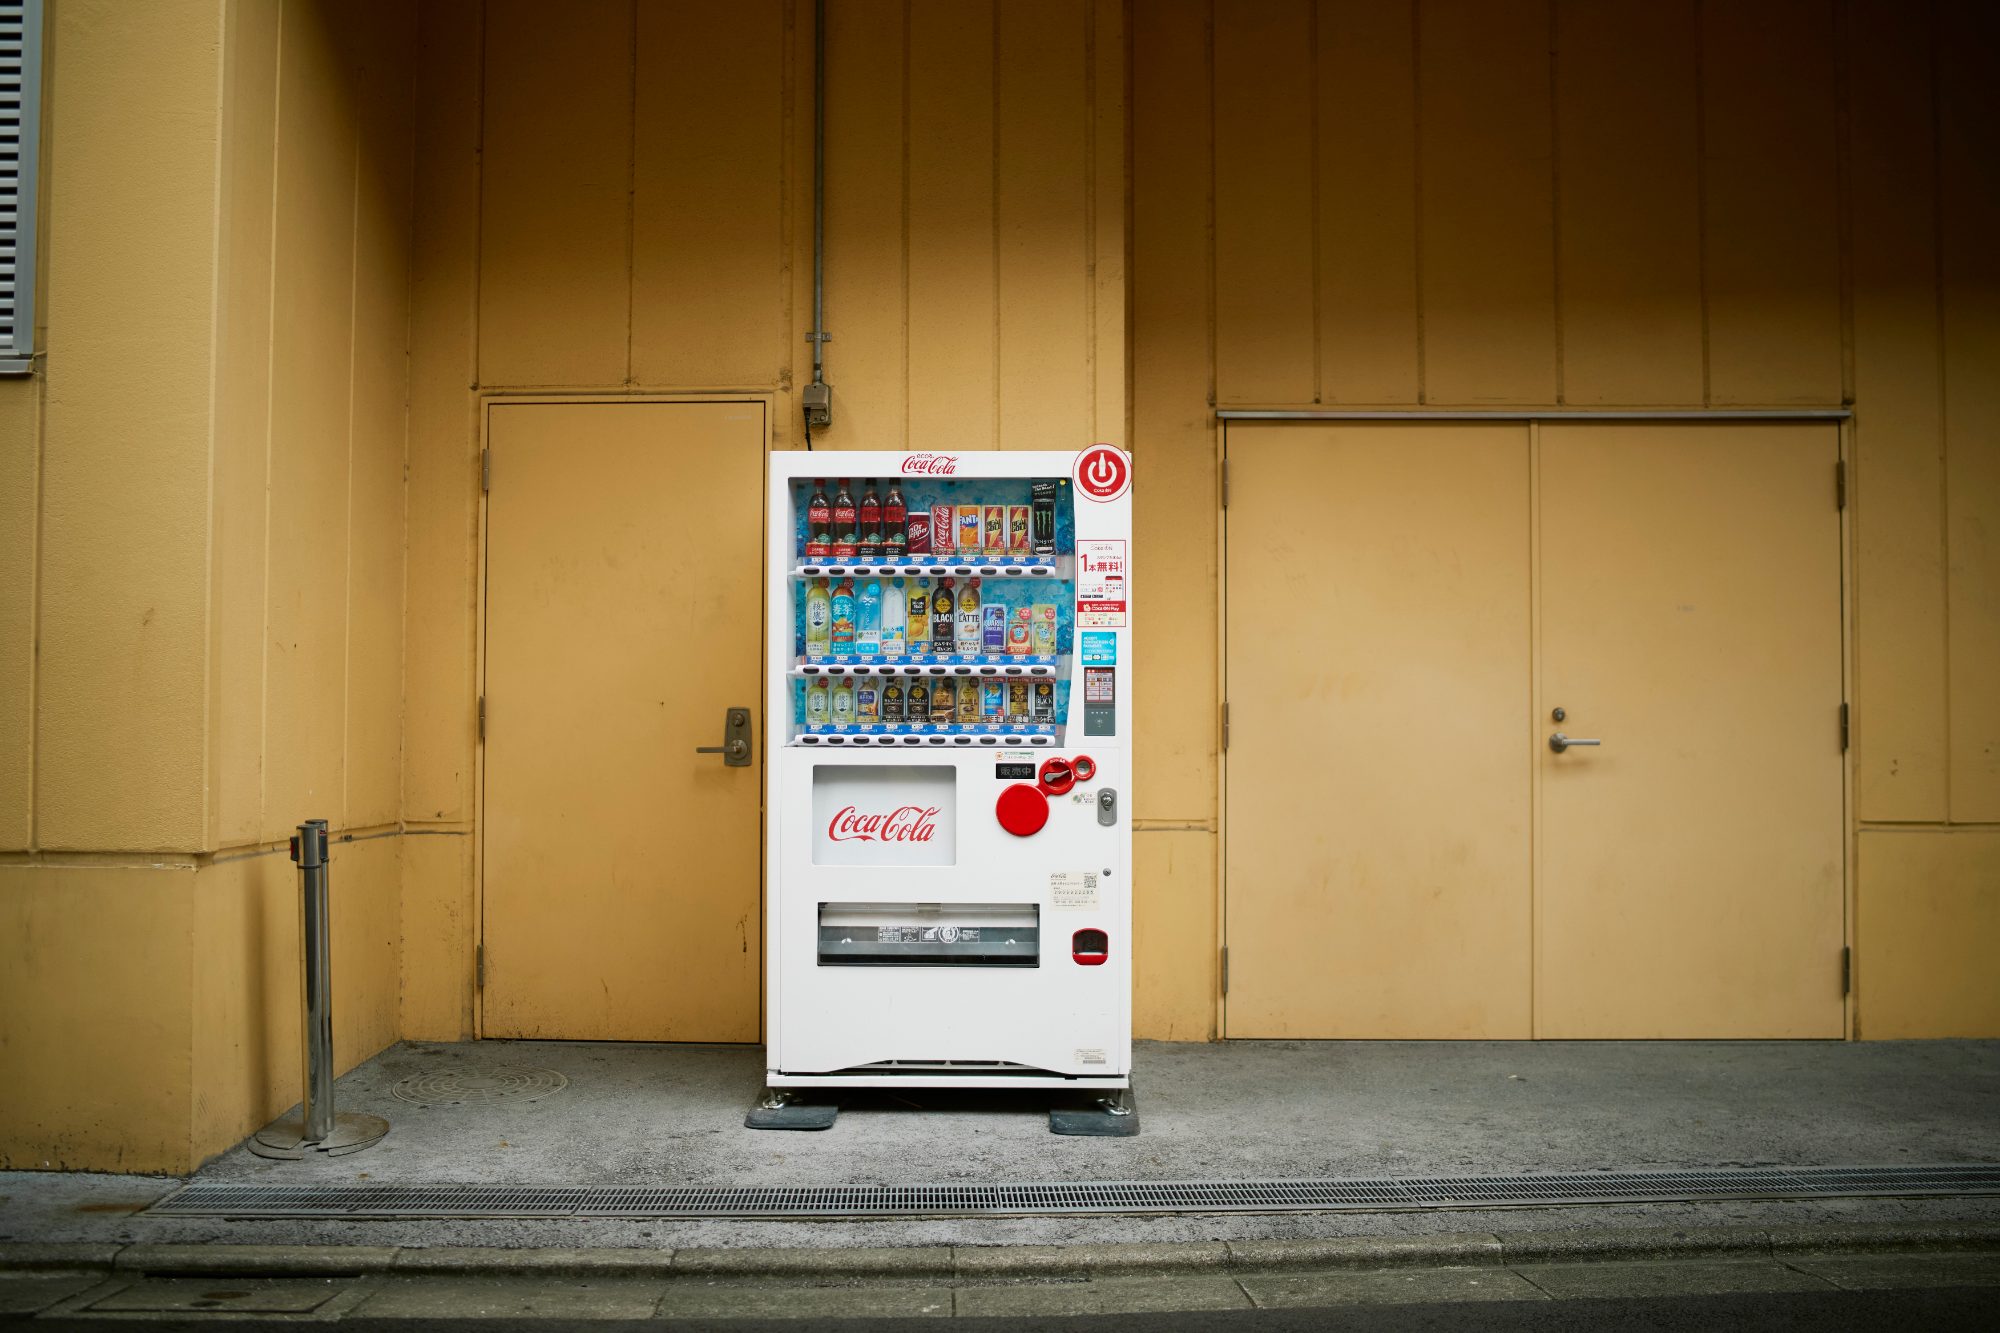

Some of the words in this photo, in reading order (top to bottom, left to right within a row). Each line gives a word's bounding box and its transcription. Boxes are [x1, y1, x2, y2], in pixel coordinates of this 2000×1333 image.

[901, 455, 959, 475] Coca-Cola
[908, 527, 927, 539] Pepper
[935, 507, 950, 547] Coca-Cola
[833, 603, 853, 615] 麦茶
[933, 614, 954, 623] BLACK
[958, 615, 979, 623] LATTE
[1000, 766, 1032, 776] 販売中
[828, 805, 943, 842] Coca-Cola
